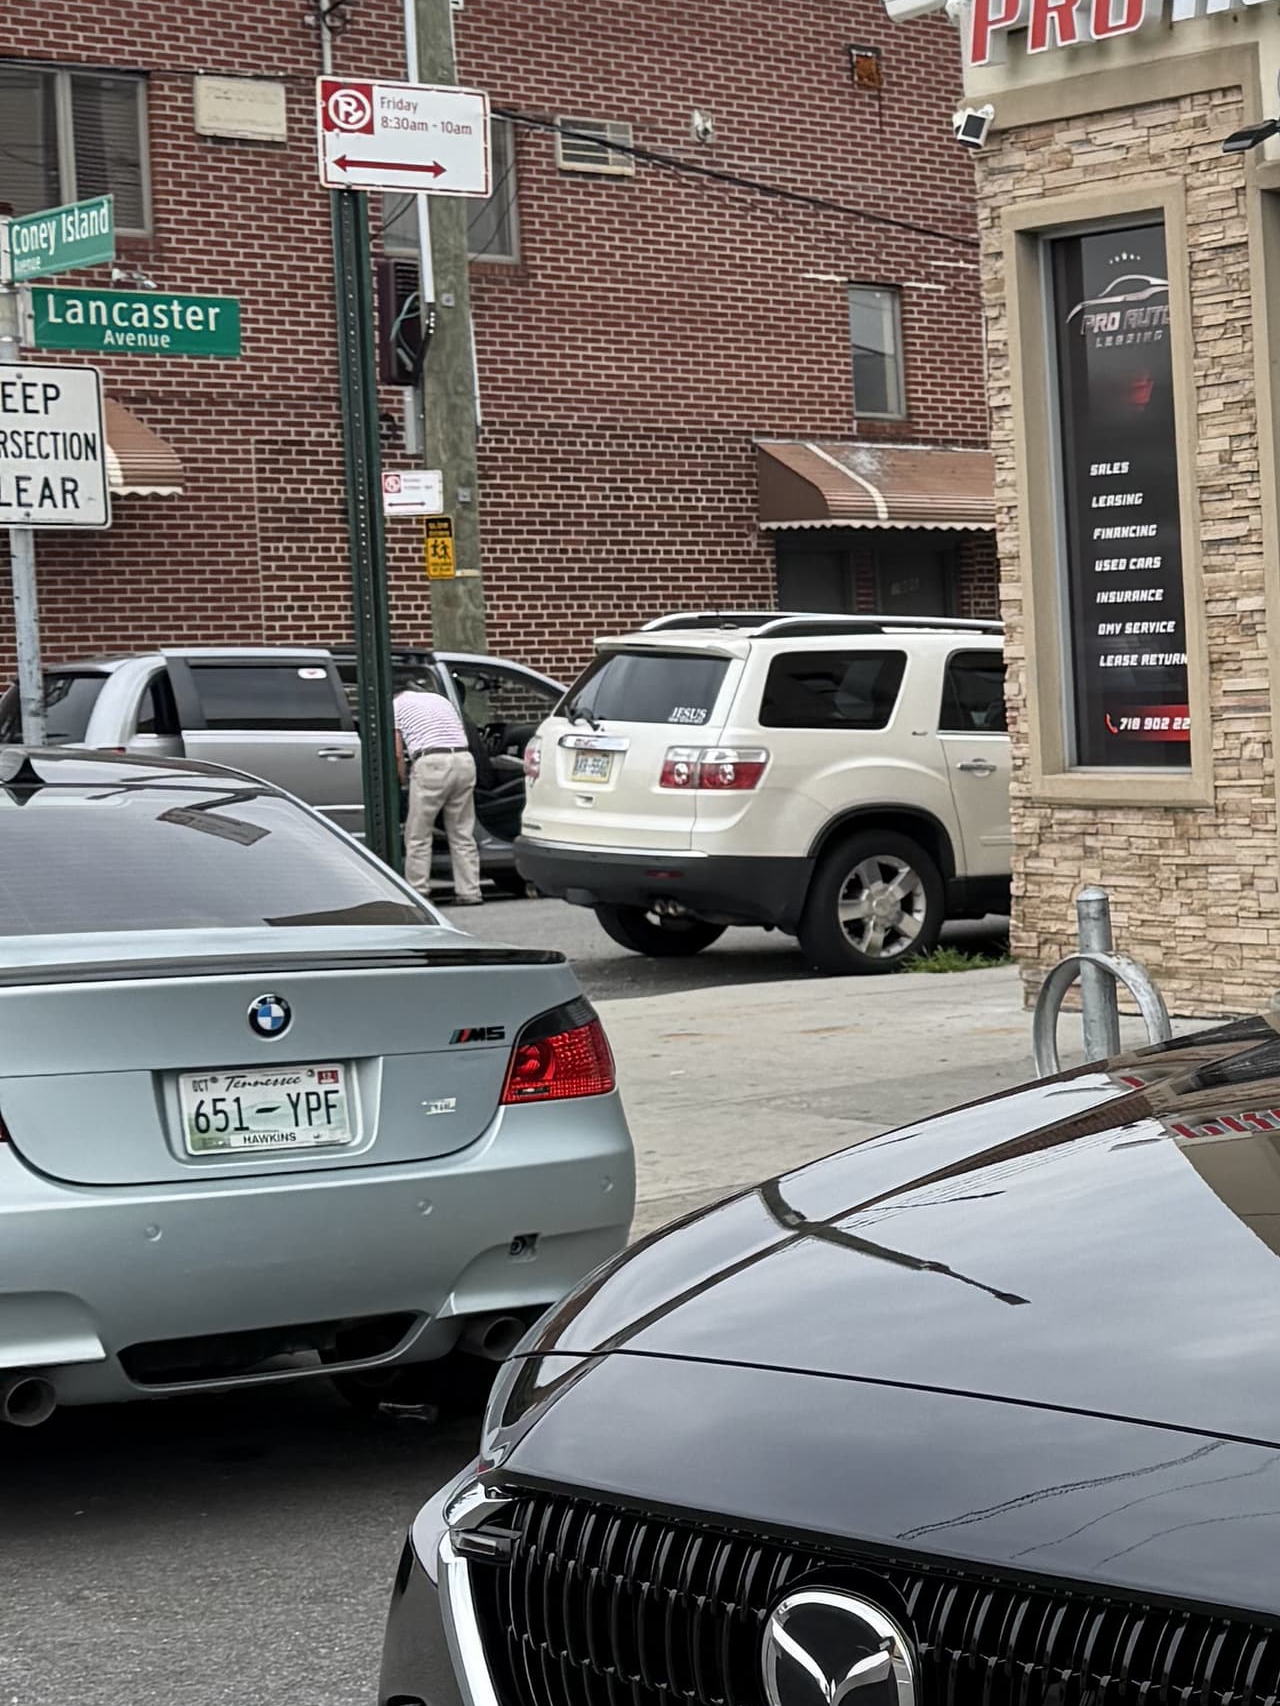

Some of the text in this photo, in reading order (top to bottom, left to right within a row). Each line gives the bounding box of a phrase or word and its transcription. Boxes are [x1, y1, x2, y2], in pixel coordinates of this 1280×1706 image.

[380, 96, 418, 114] Friday
[381, 116, 428, 131] 8:30am
[441, 121, 472, 135] 10am
[12, 200, 110, 255] Coney Island
[48, 294, 220, 331] Lancaster
[1080, 311, 1120, 335] PRO
[103, 329, 171, 348] Avenue
[1, 382, 60, 415] EEP
[1090, 461, 1130, 476] SALES
[1091, 493, 1143, 508] LEASING
[1093, 524, 1157, 540] FINANCING
[1094, 556, 1162, 571] USED CARS
[1096, 589, 1164, 603] INSURANCE
[1124, 621, 1176, 634] SERVICE
[1099, 654, 1138, 667] LEASE
[1119, 717, 1139, 730] 718
[1144, 717, 1170, 730] 902
[225, 1075, 301, 1092] Tennessee
[194, 1089, 340, 1134] 651 YPF
[243, 1132, 296, 1145] HAWKINS
